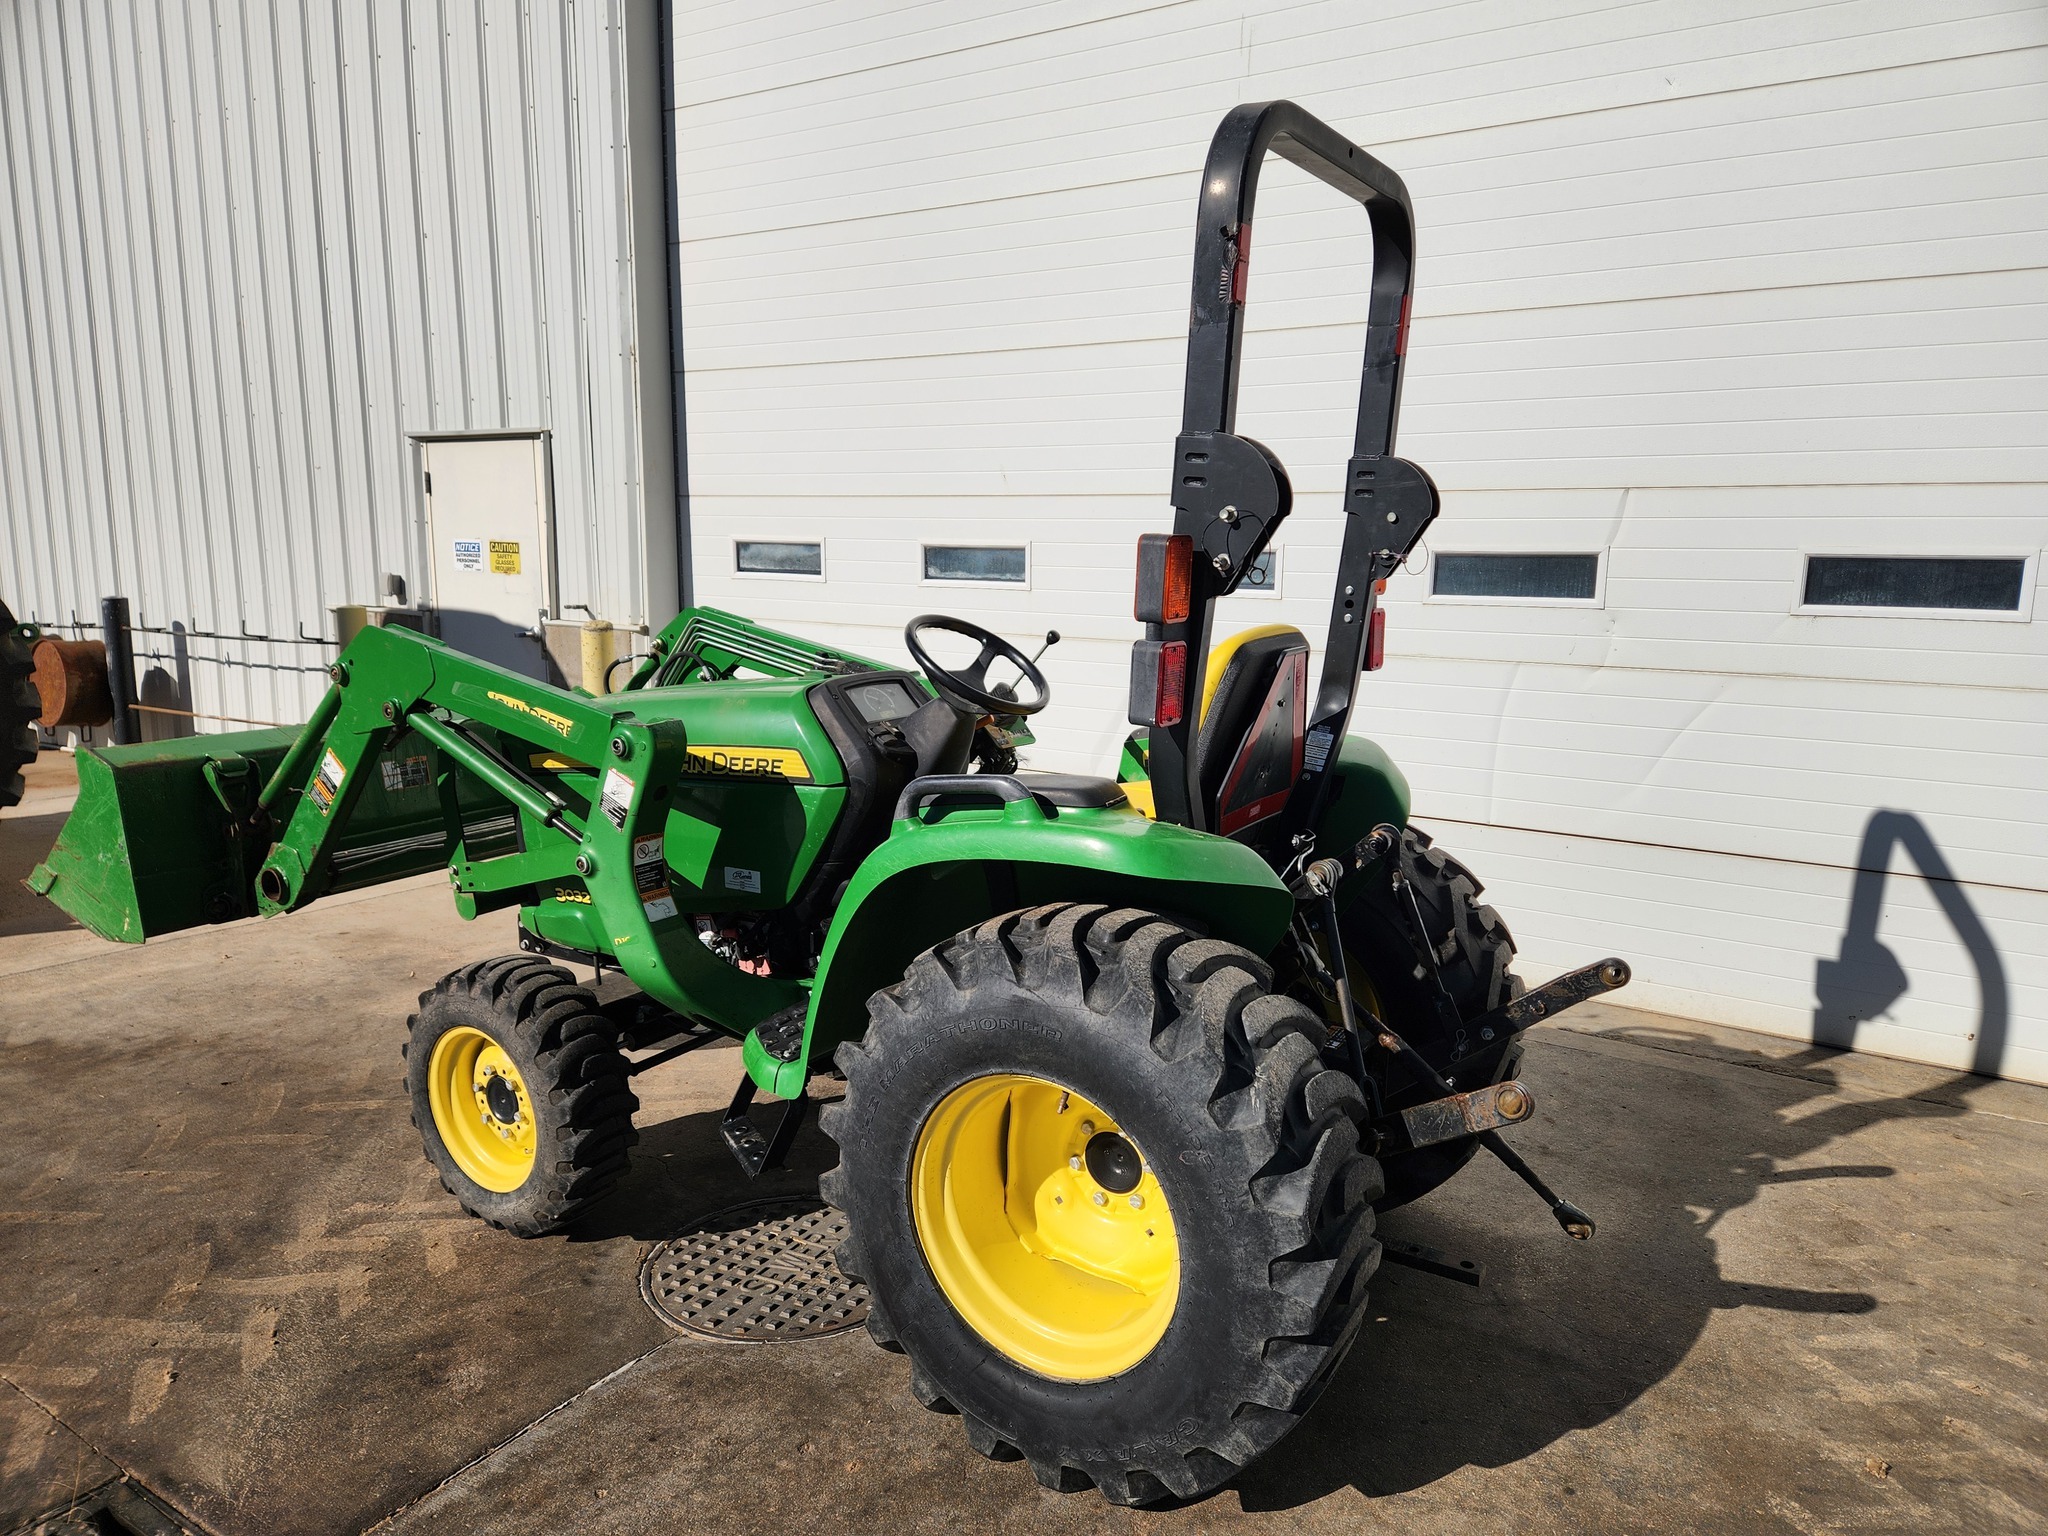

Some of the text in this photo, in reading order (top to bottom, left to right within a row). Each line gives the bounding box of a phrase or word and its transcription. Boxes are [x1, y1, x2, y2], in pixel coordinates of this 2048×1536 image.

[455, 543, 479, 551] NOTICE
[490, 542, 518, 552] CAUTION
[711, 752, 784, 775] DEERE
[554, 886, 591, 903] 3032
[878, 1017, 1064, 1091] MARATHONER
[740, 1232, 841, 1296] SEWER
